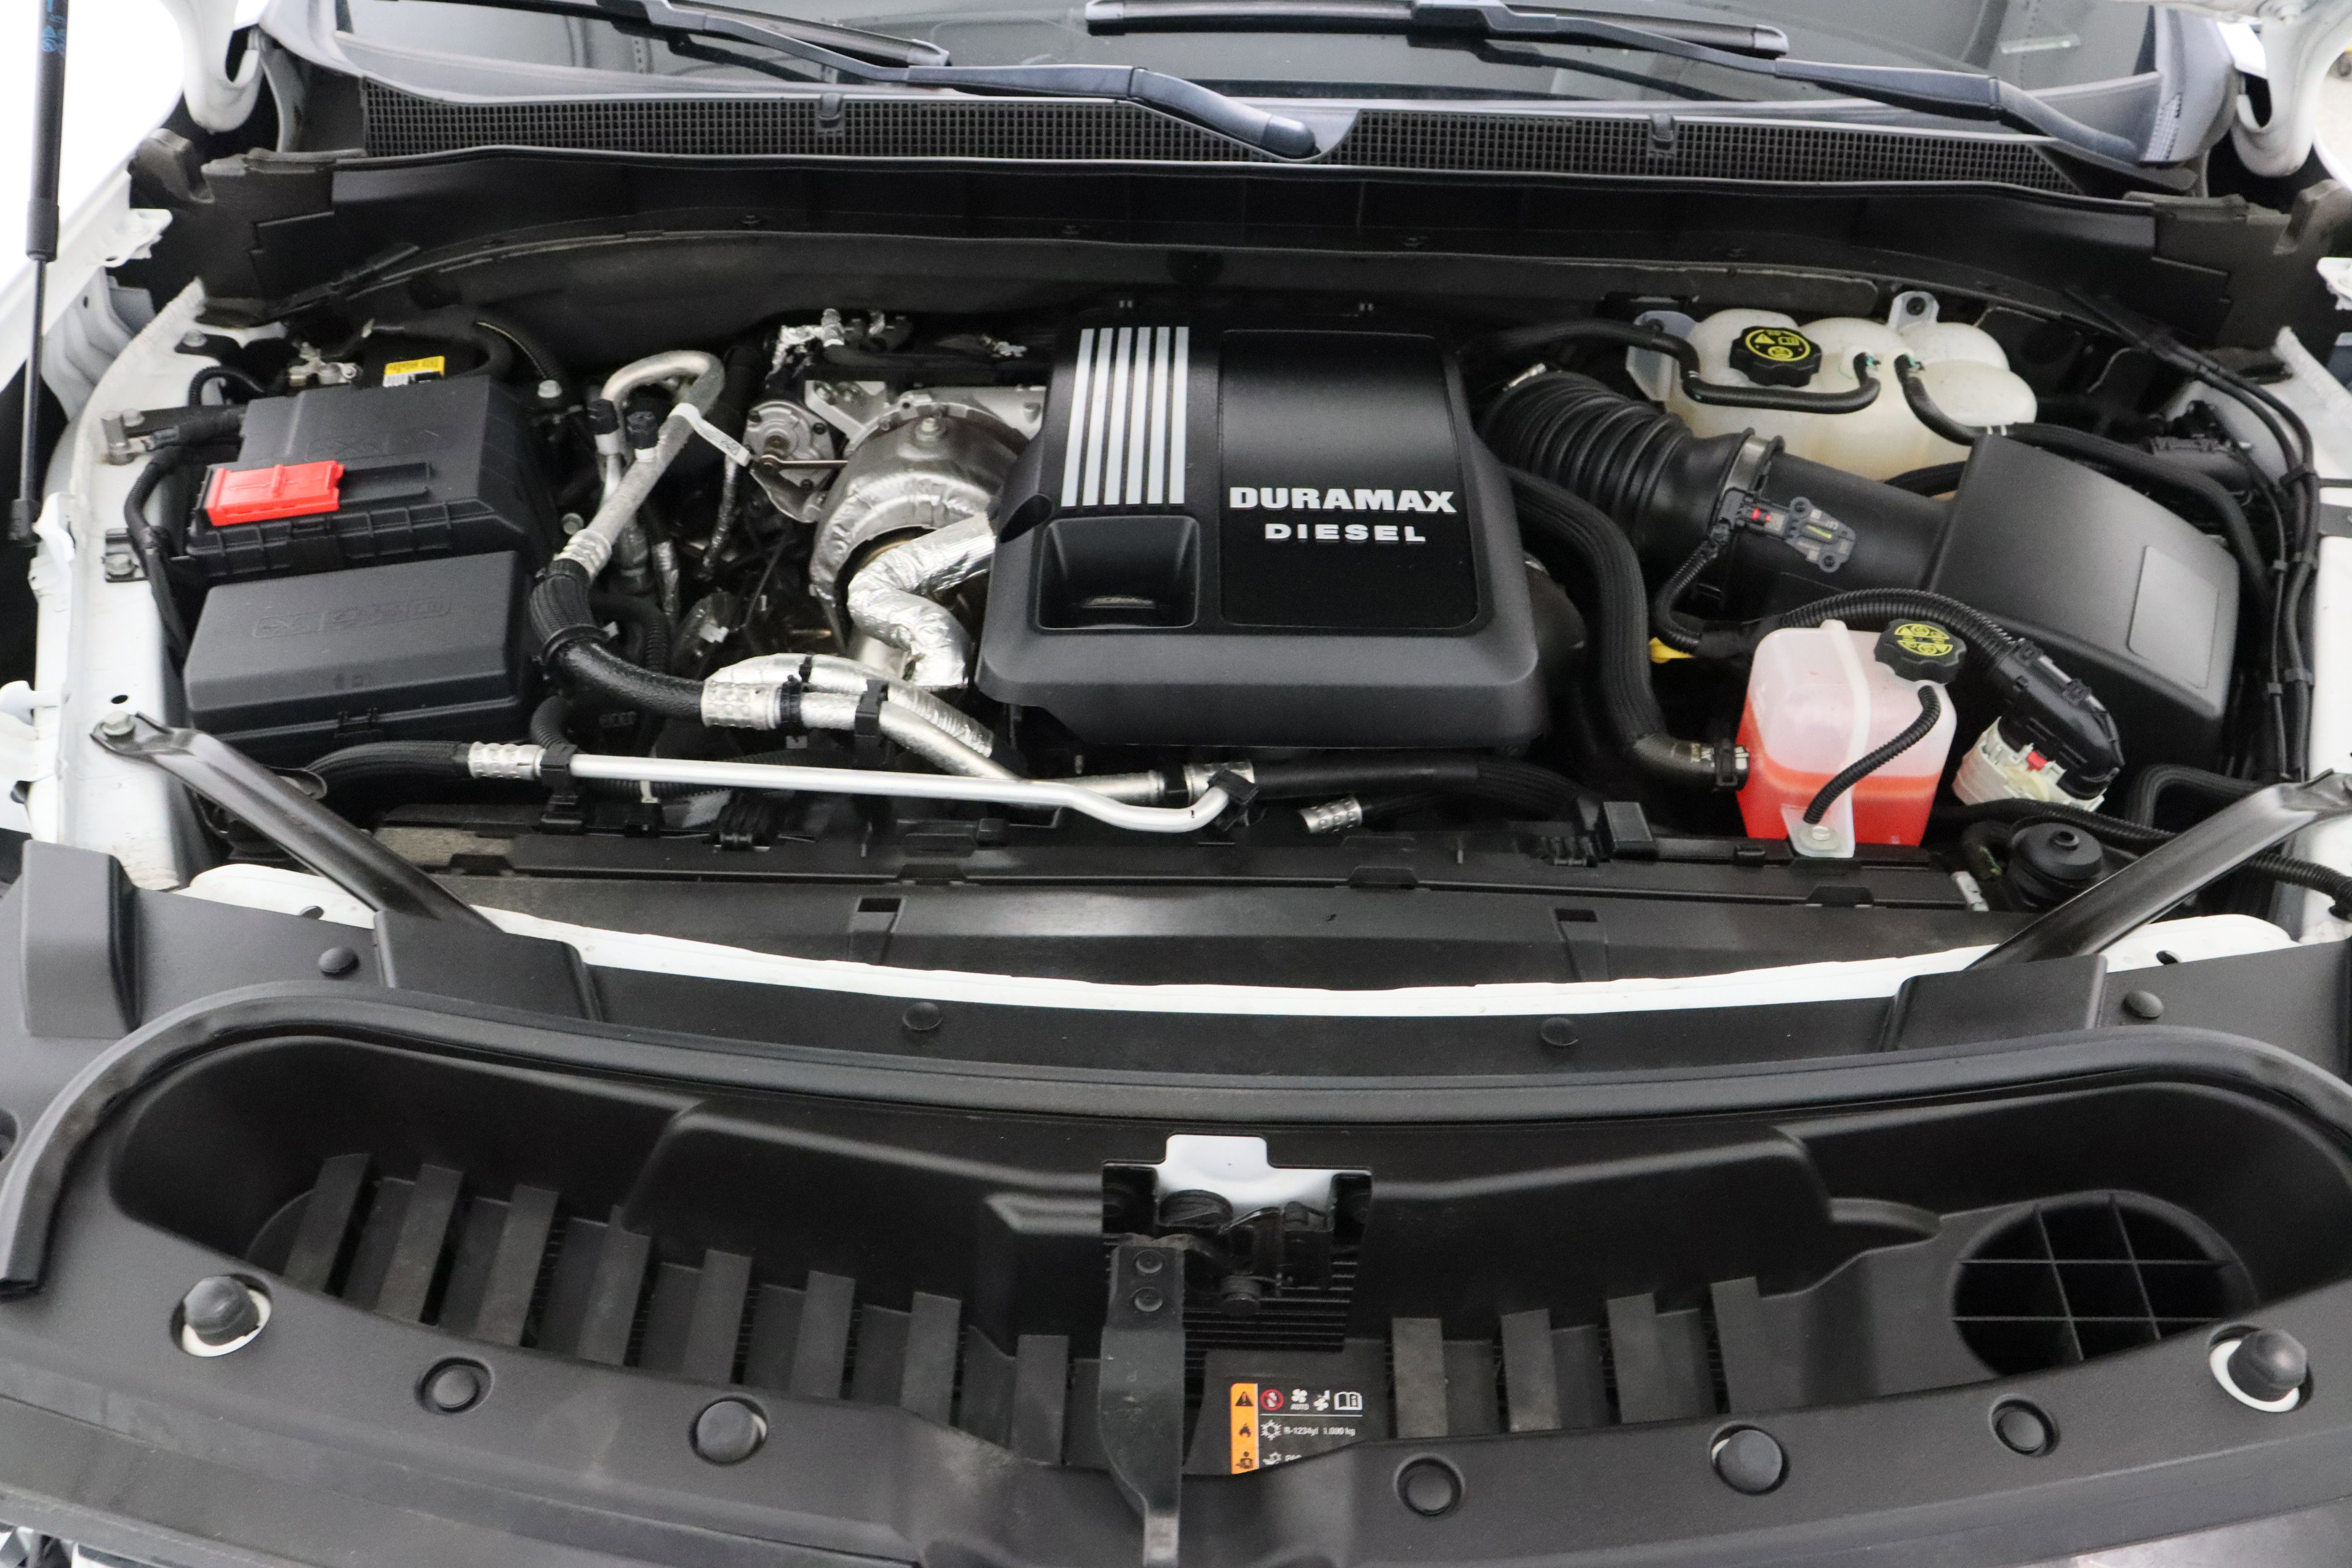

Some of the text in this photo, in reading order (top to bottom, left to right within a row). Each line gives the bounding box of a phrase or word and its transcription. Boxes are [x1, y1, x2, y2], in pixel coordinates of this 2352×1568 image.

[1229, 486, 1457, 513] DURAMAX
[1265, 523, 1426, 543] DIESEL
[1283, 1426, 1319, 1436] R-1234yf
[1345, 1427, 1356, 1436] kg
